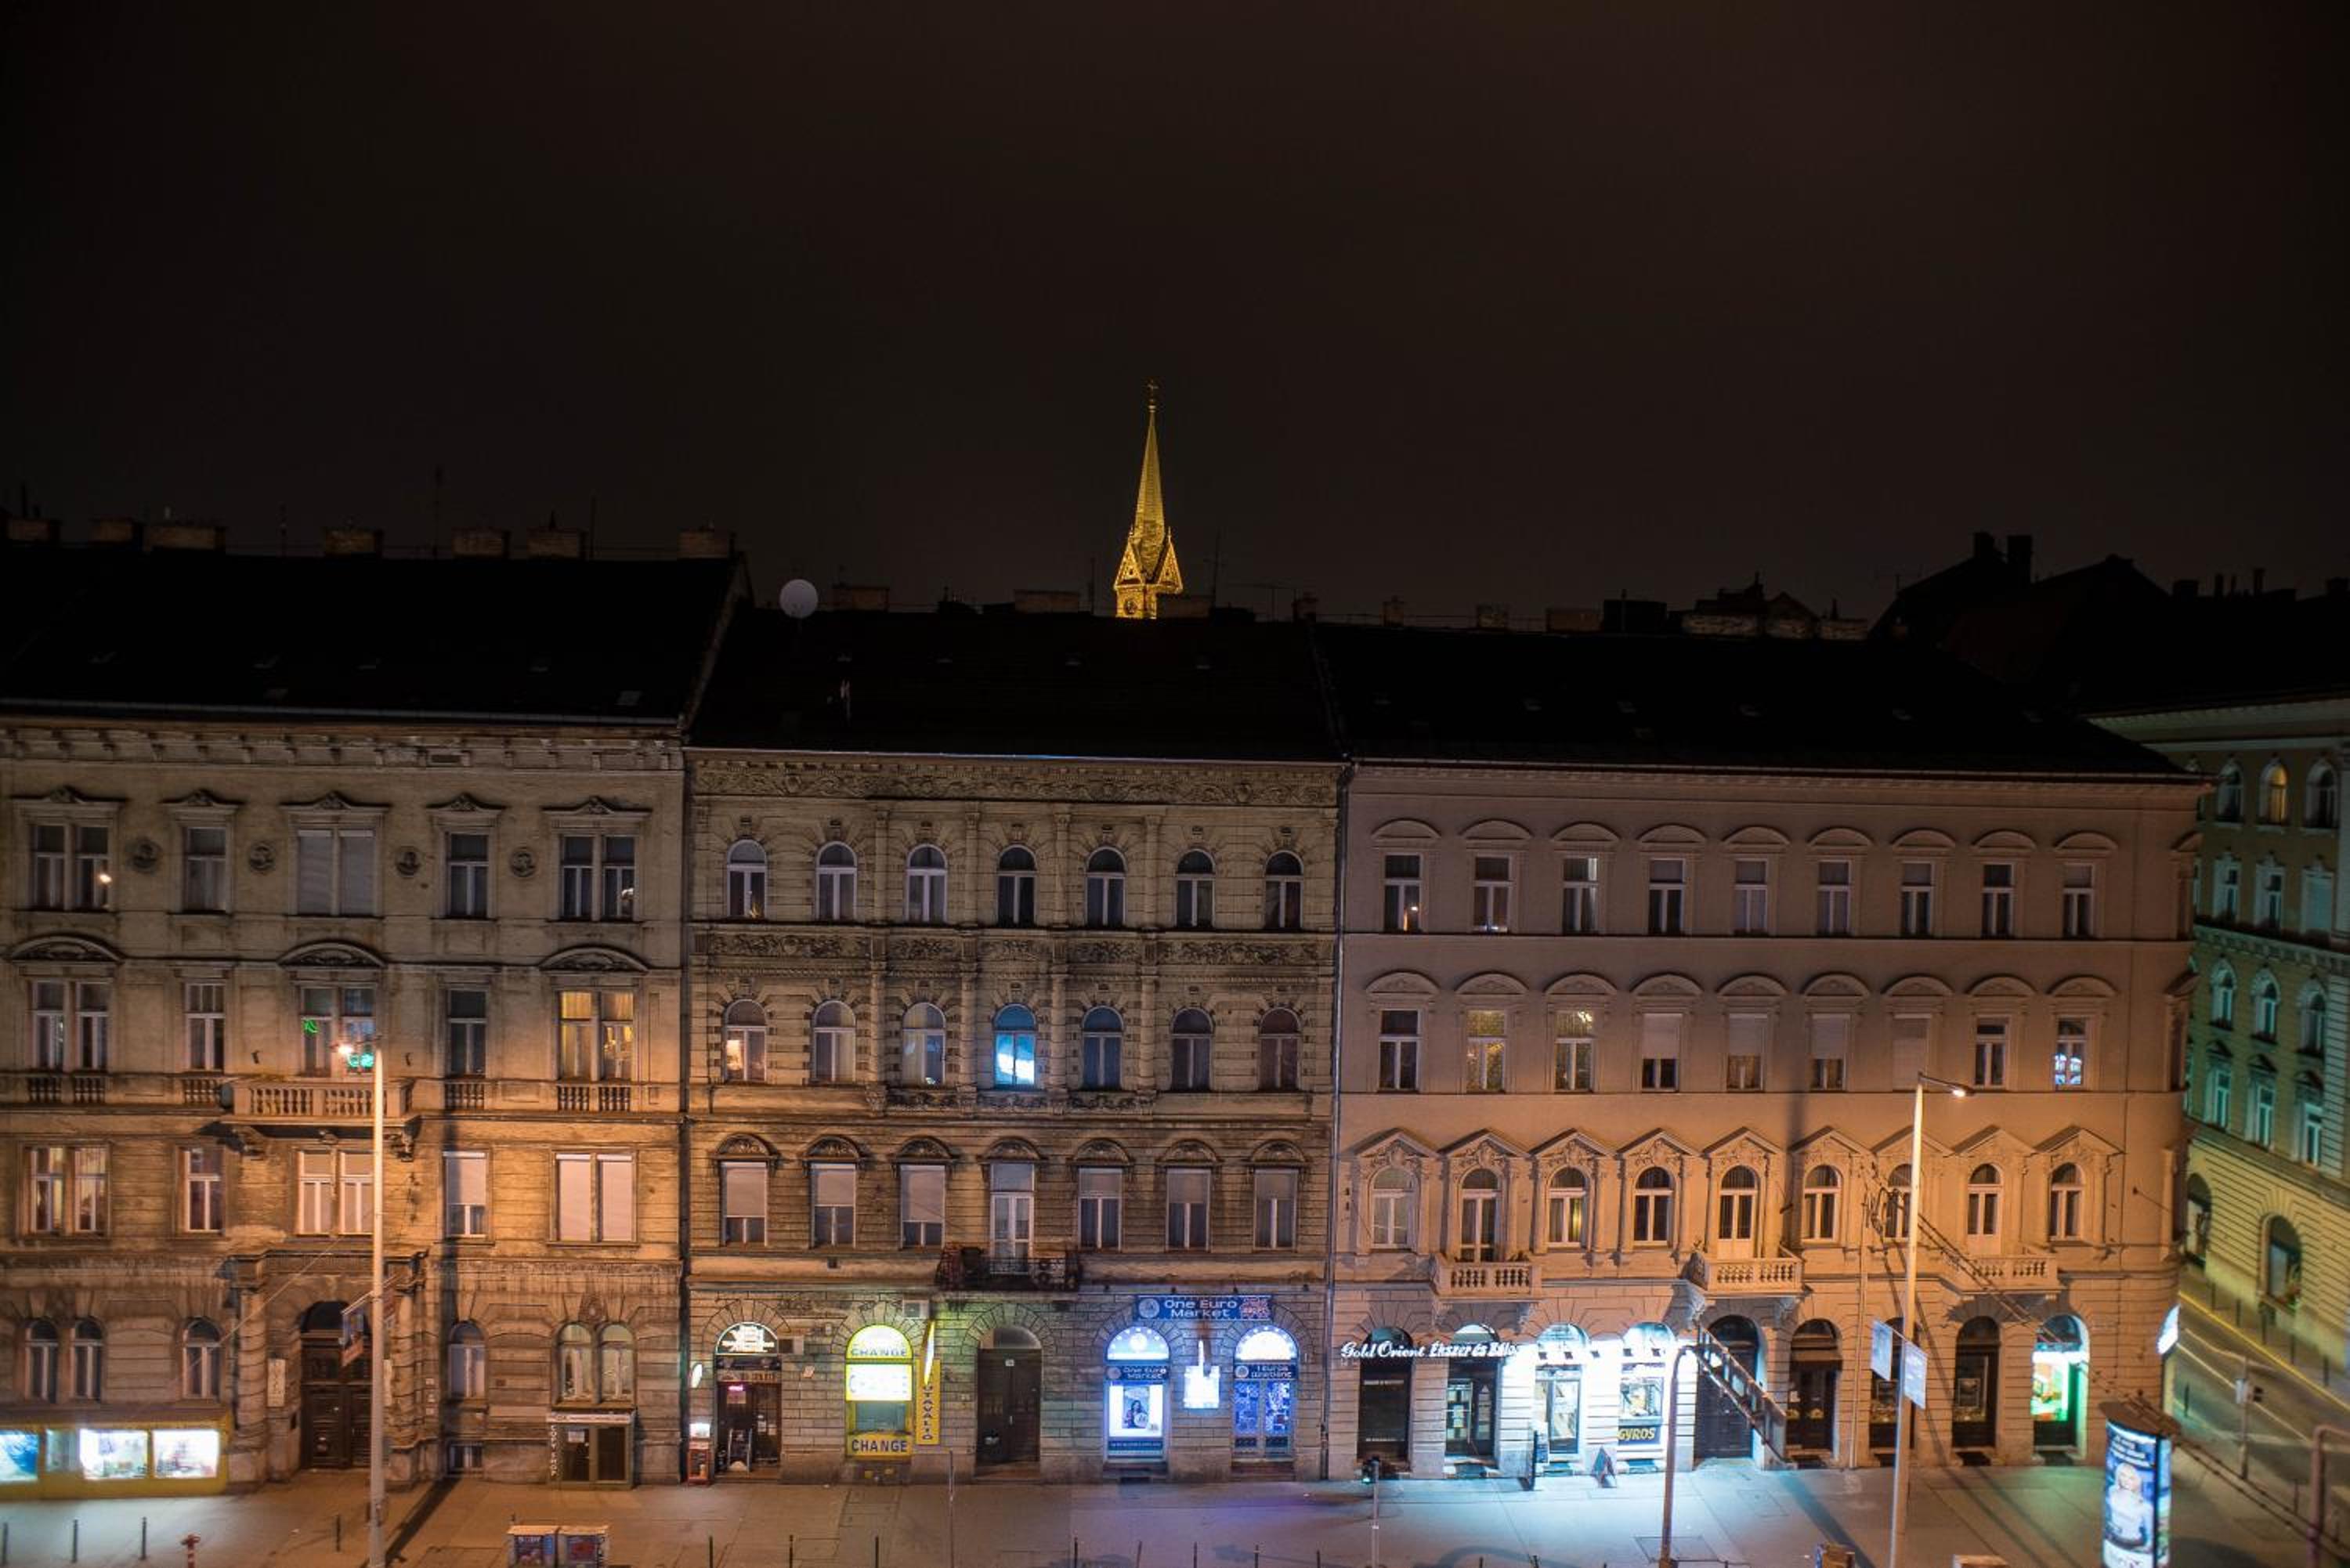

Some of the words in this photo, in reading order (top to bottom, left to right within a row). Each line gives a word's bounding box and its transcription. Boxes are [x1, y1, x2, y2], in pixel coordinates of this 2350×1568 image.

[1164, 1299, 1196, 1309] One
[1199, 1299, 1238, 1309] Euro
[1171, 1309, 1231, 1318] Market
[851, 1348, 908, 1357] CHANGE
[1341, 1341, 1376, 1358] Gold
[1377, 1340, 1425, 1358] Orient
[1617, 1428, 1655, 1440] GYROS
[851, 1440, 908, 1452] CHANGE
